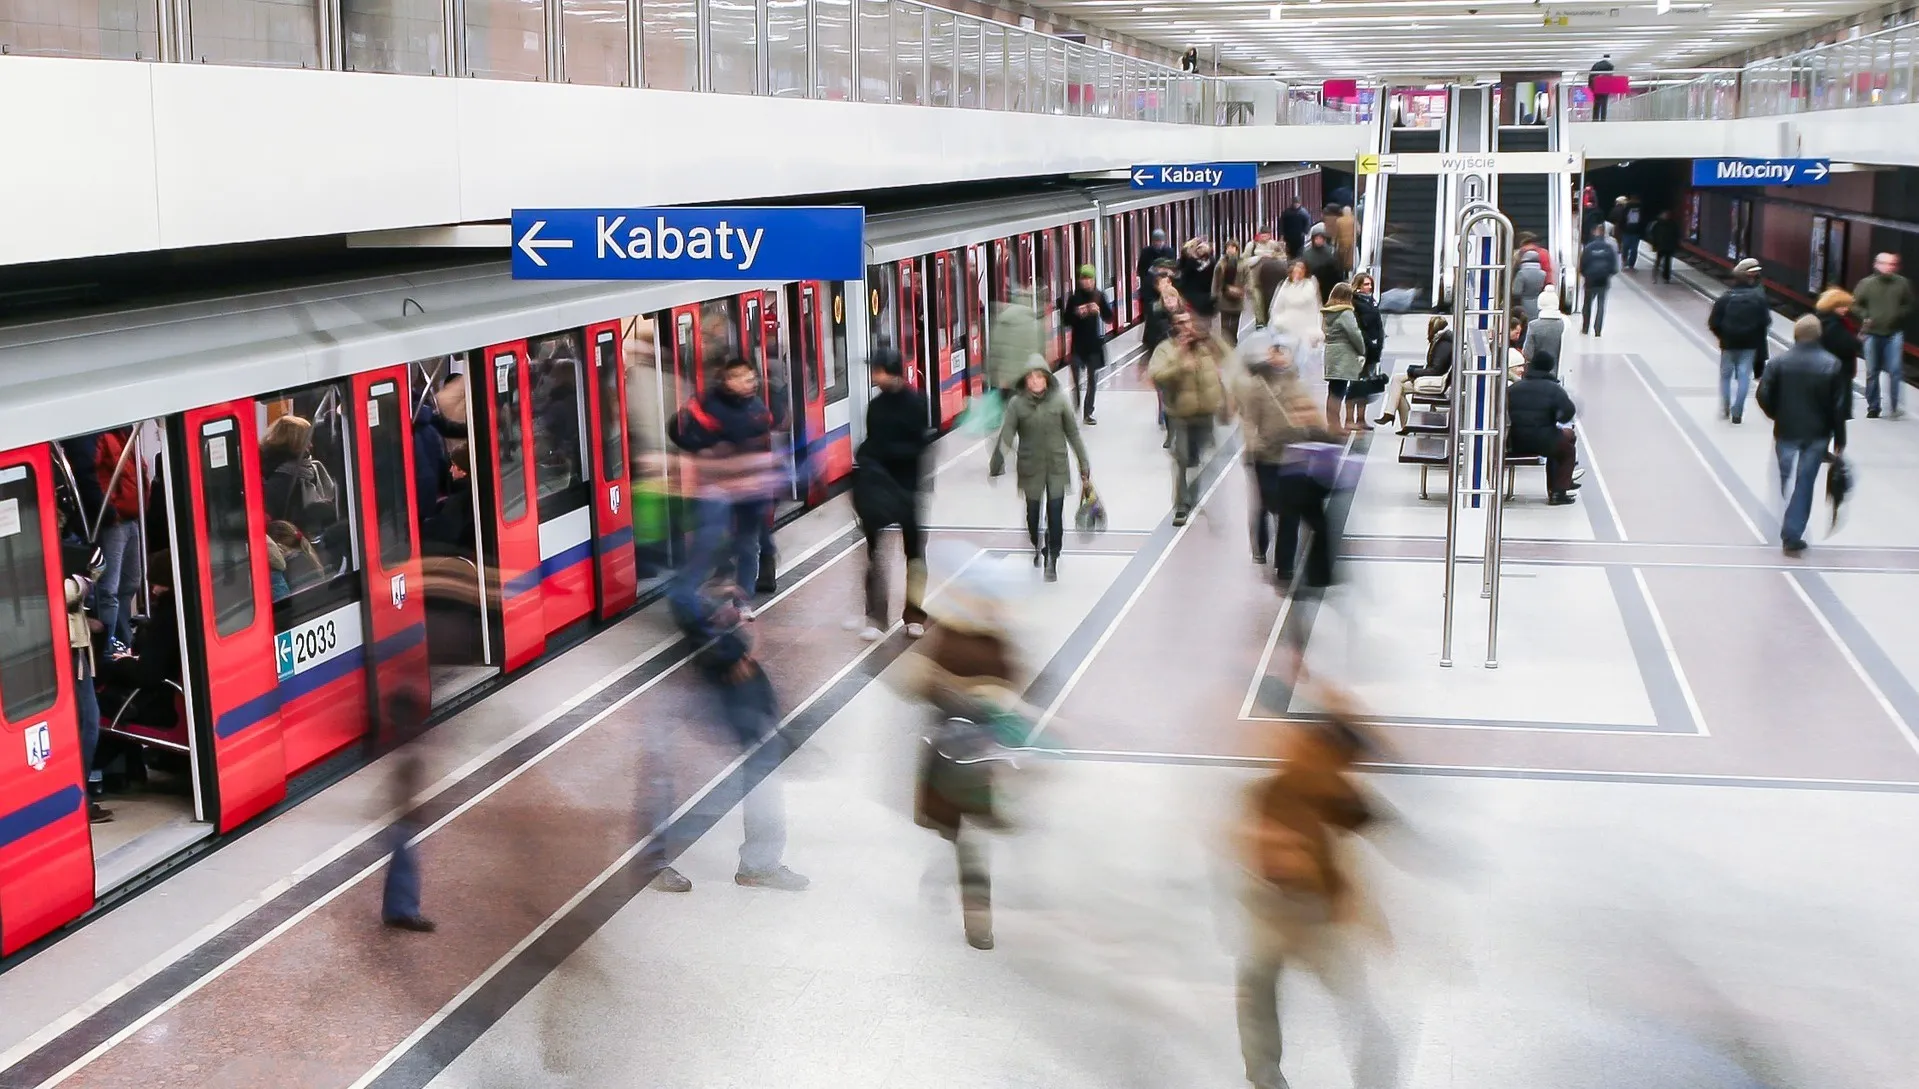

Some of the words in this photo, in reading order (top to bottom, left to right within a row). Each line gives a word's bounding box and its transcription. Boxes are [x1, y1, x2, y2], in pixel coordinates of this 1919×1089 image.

[1442, 156, 1495, 171] wyjście
[1717, 161, 1795, 182] Młociny
[1161, 167, 1222, 185] Kabaty
[597, 216, 764, 270] Kabaty
[295, 620, 336, 664] 2033
